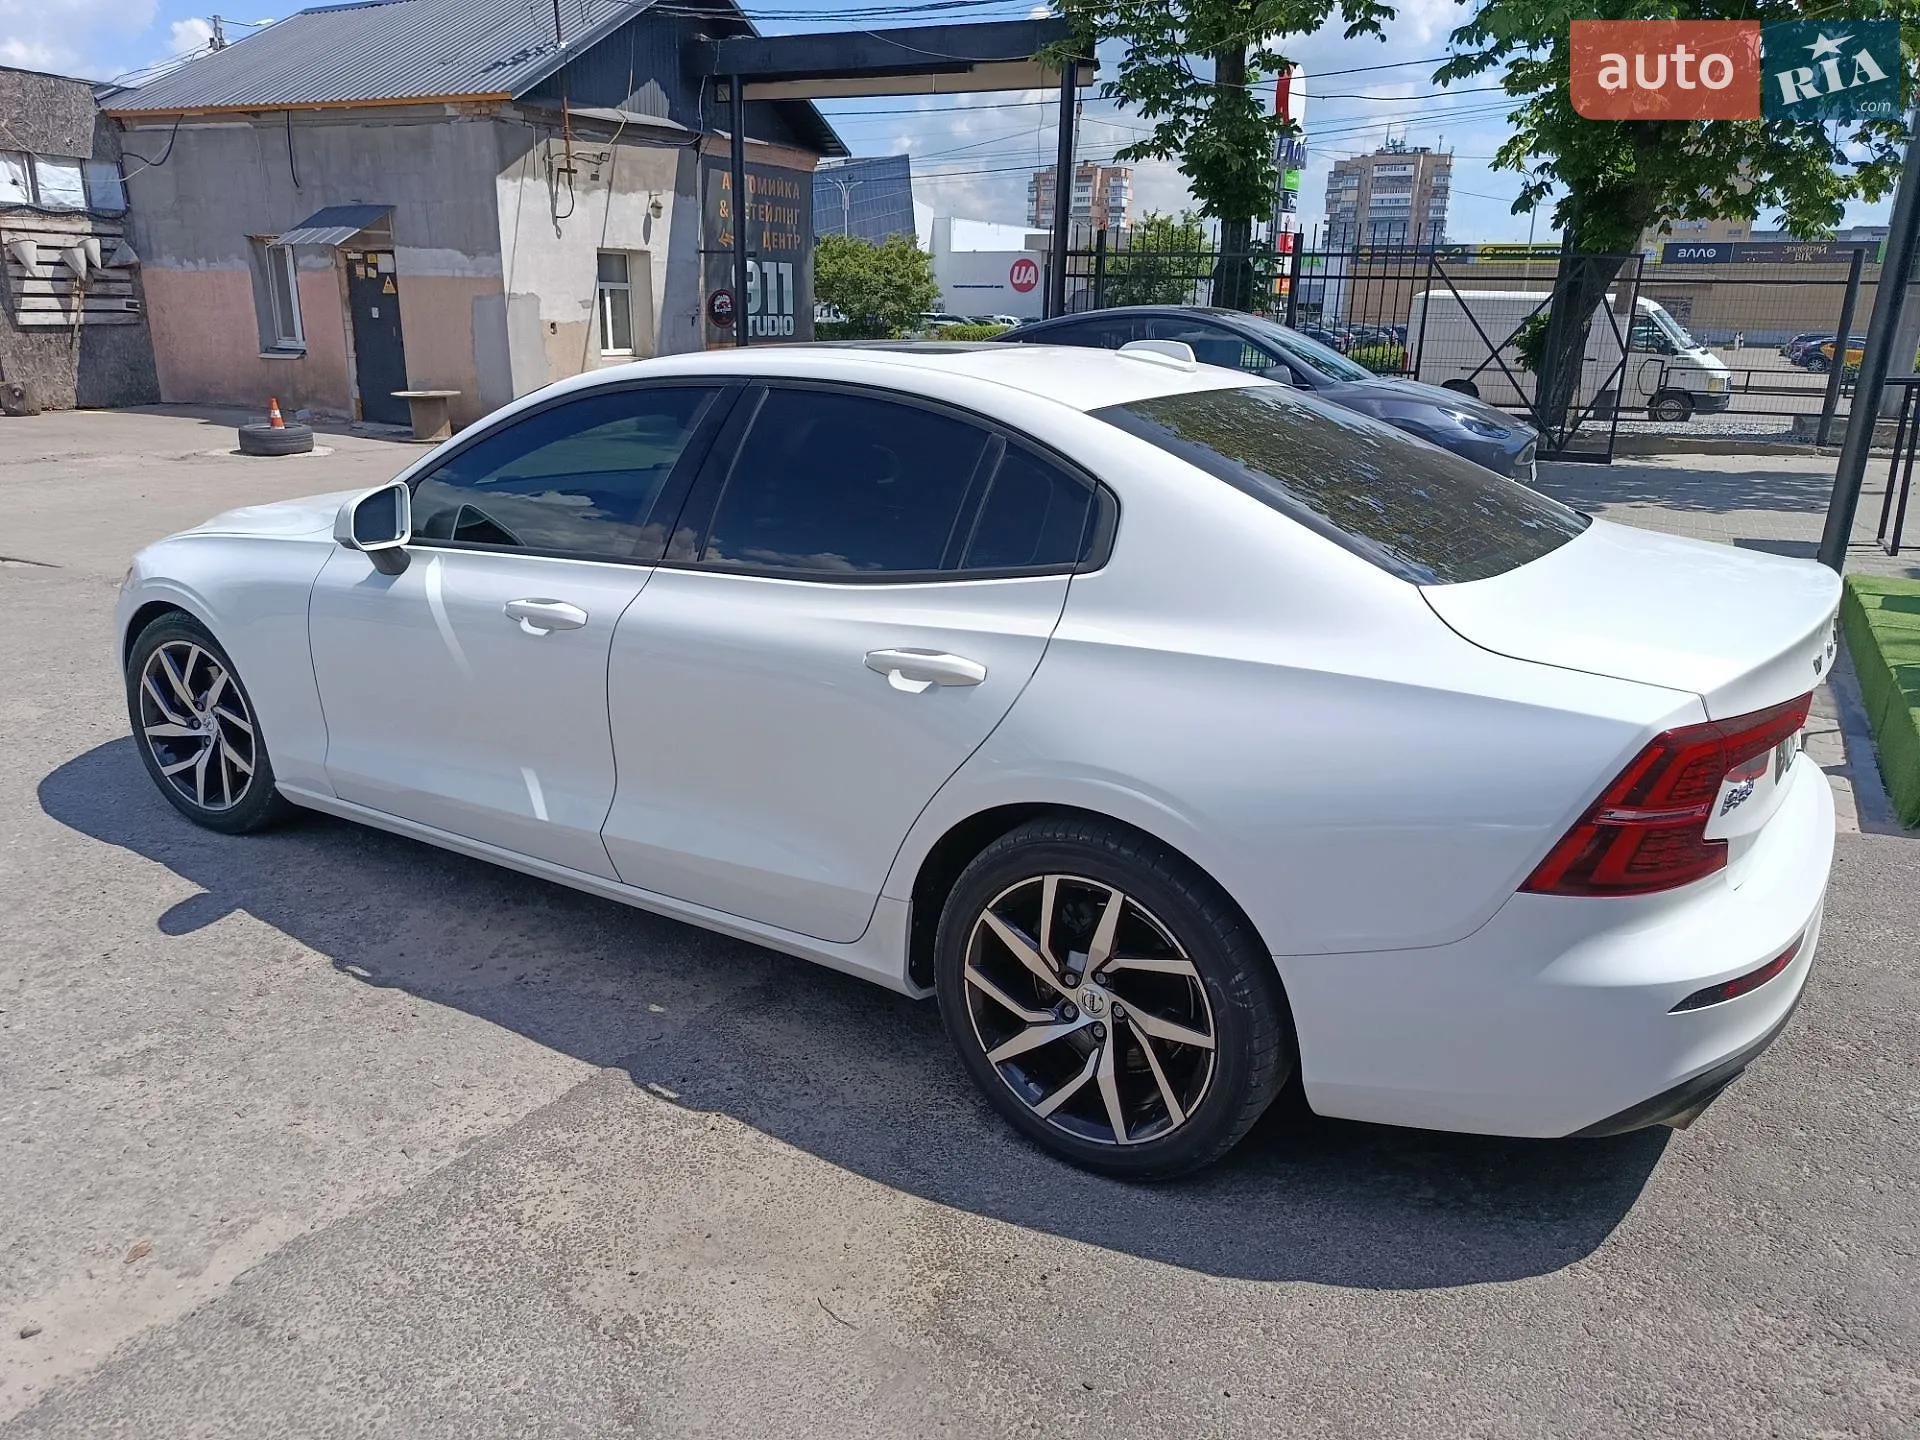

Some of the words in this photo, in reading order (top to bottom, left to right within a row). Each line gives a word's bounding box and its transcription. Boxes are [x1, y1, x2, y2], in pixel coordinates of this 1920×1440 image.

[722, 171, 801, 200] АОМИЙКА
[762, 230, 801, 252] ЦЕНТР
[1011, 265, 1037, 285] UA
